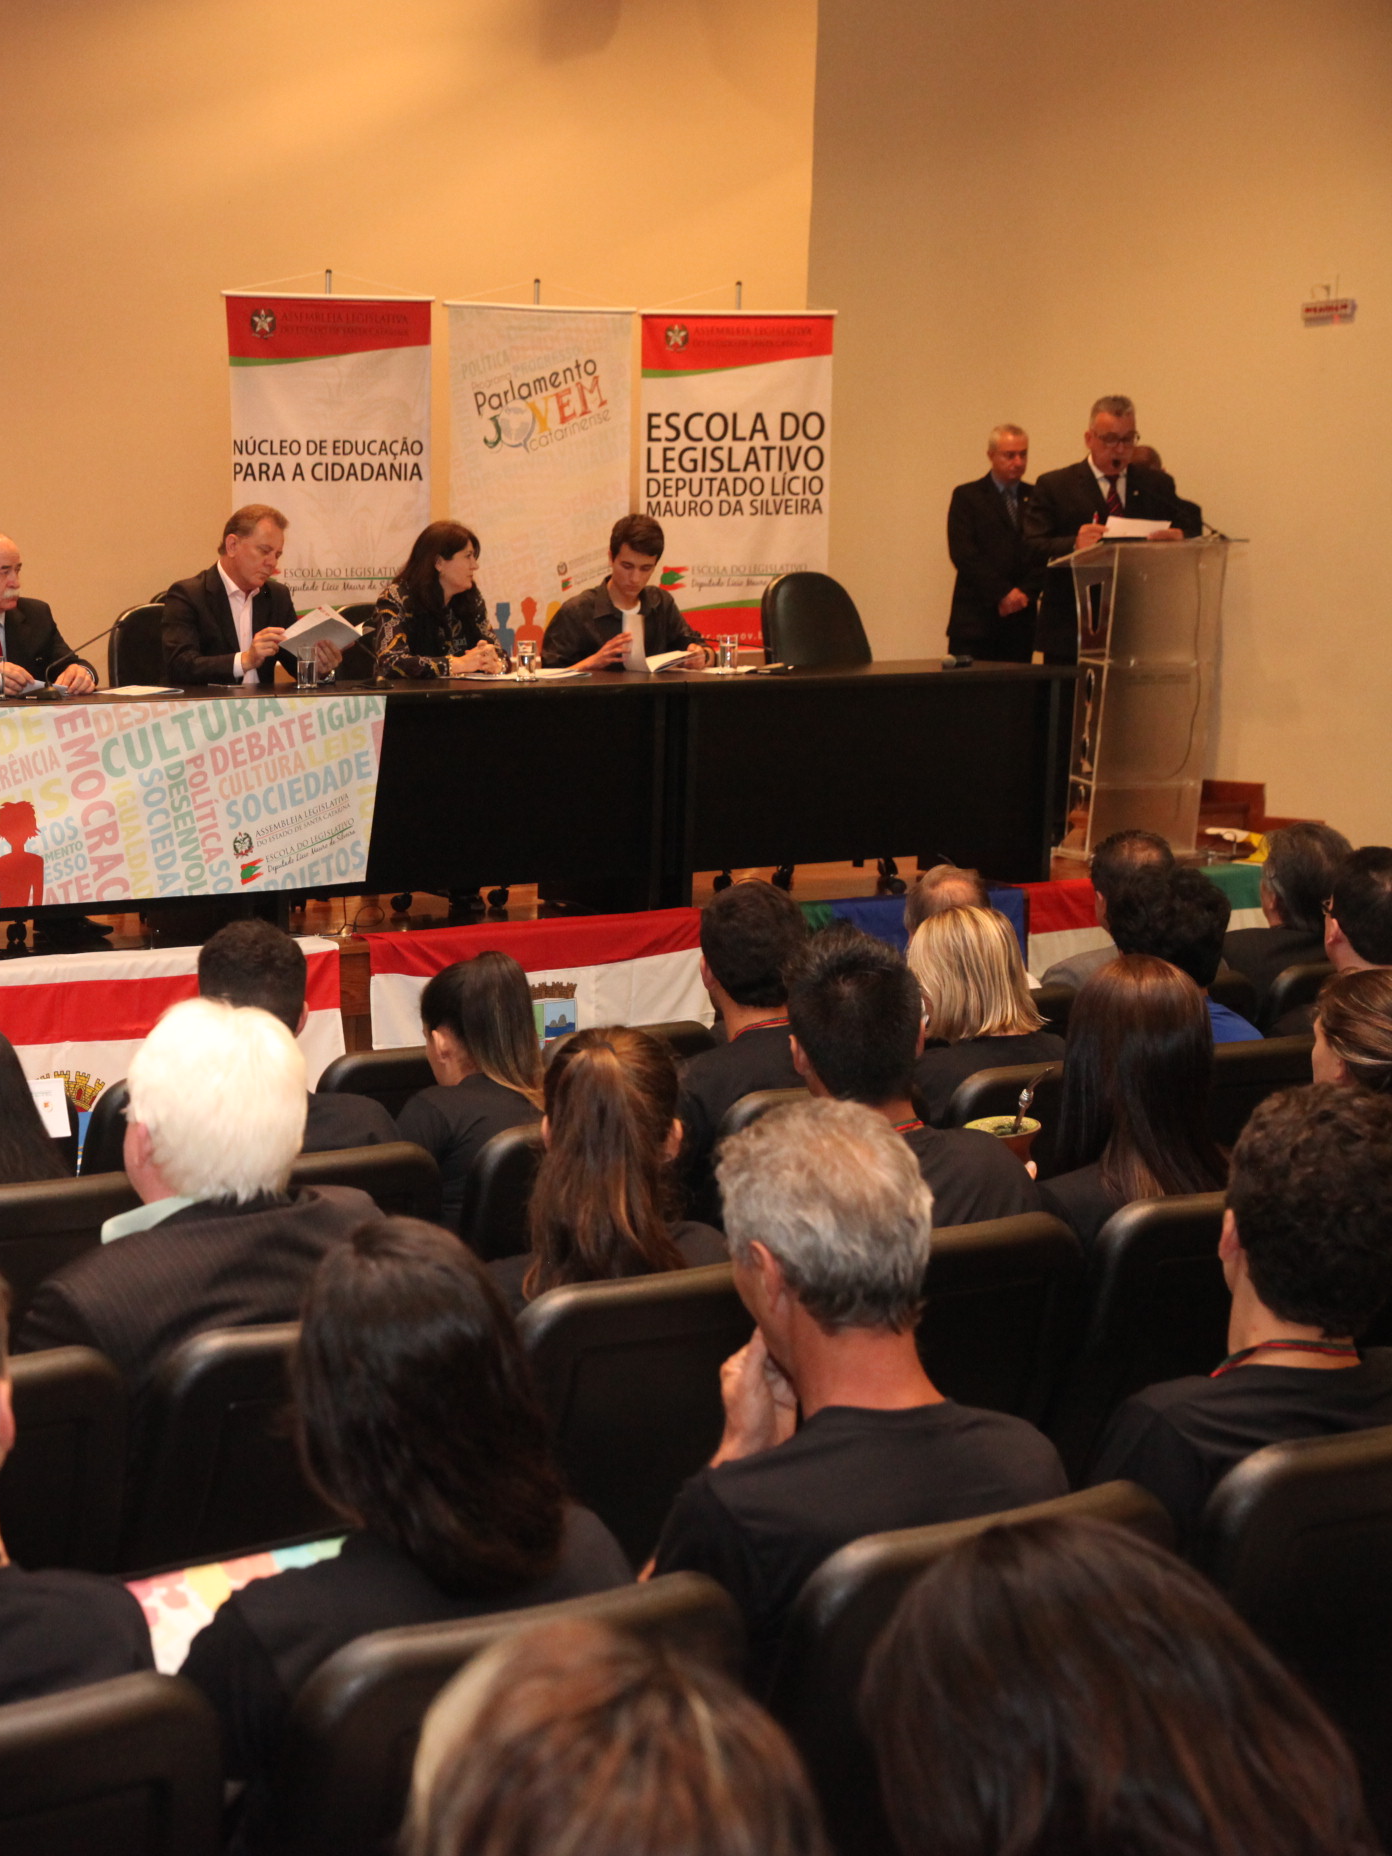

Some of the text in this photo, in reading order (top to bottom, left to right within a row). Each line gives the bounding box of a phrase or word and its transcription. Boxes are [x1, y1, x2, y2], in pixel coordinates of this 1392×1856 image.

[474, 359, 597, 416] Parlamento
[233, 436, 424, 460] NÚCLEO DE EDUCAÇÃO
[528, 409, 612, 452] catarinense
[647, 411, 825, 442] ESCOLA DO
[233, 462, 423, 482] PARA A CIDADANIA
[646, 444, 825, 473] LEGISLATIVO
[646, 471, 824, 498] DEPUTADO LÍCIO
[646, 499, 714, 518] MAURO
[718, 499, 744, 516] DA
[749, 498, 823, 516] SILVEIRA
[283, 567, 400, 578] ESCOLA DO LEGISLATIV
[691, 565, 727, 575] ESCOLA
[730, 565, 746, 574] DO
[101, 698, 284, 778] CULTURA
[210, 712, 317, 777] DEBATE
[306, 726, 368, 769] LEIS
[218, 749, 307, 800] CULTURA
[225, 750, 373, 831] SOCIEDADE
[163, 759, 210, 896] DESENVOL
[185, 753, 225, 865] POLÍTICA
[255, 814, 303, 837] ASSEMBLEIA
[303, 793, 350, 819] LEGISLATIVA
[256, 803, 352, 848] DO ESTADO DE SANTA CATARINA
[111, 780, 155, 898] IGUALDAD
[265, 817, 355, 863] ESCOLA DO LEGISLATIVO
[267, 857, 295, 874] Deputado
